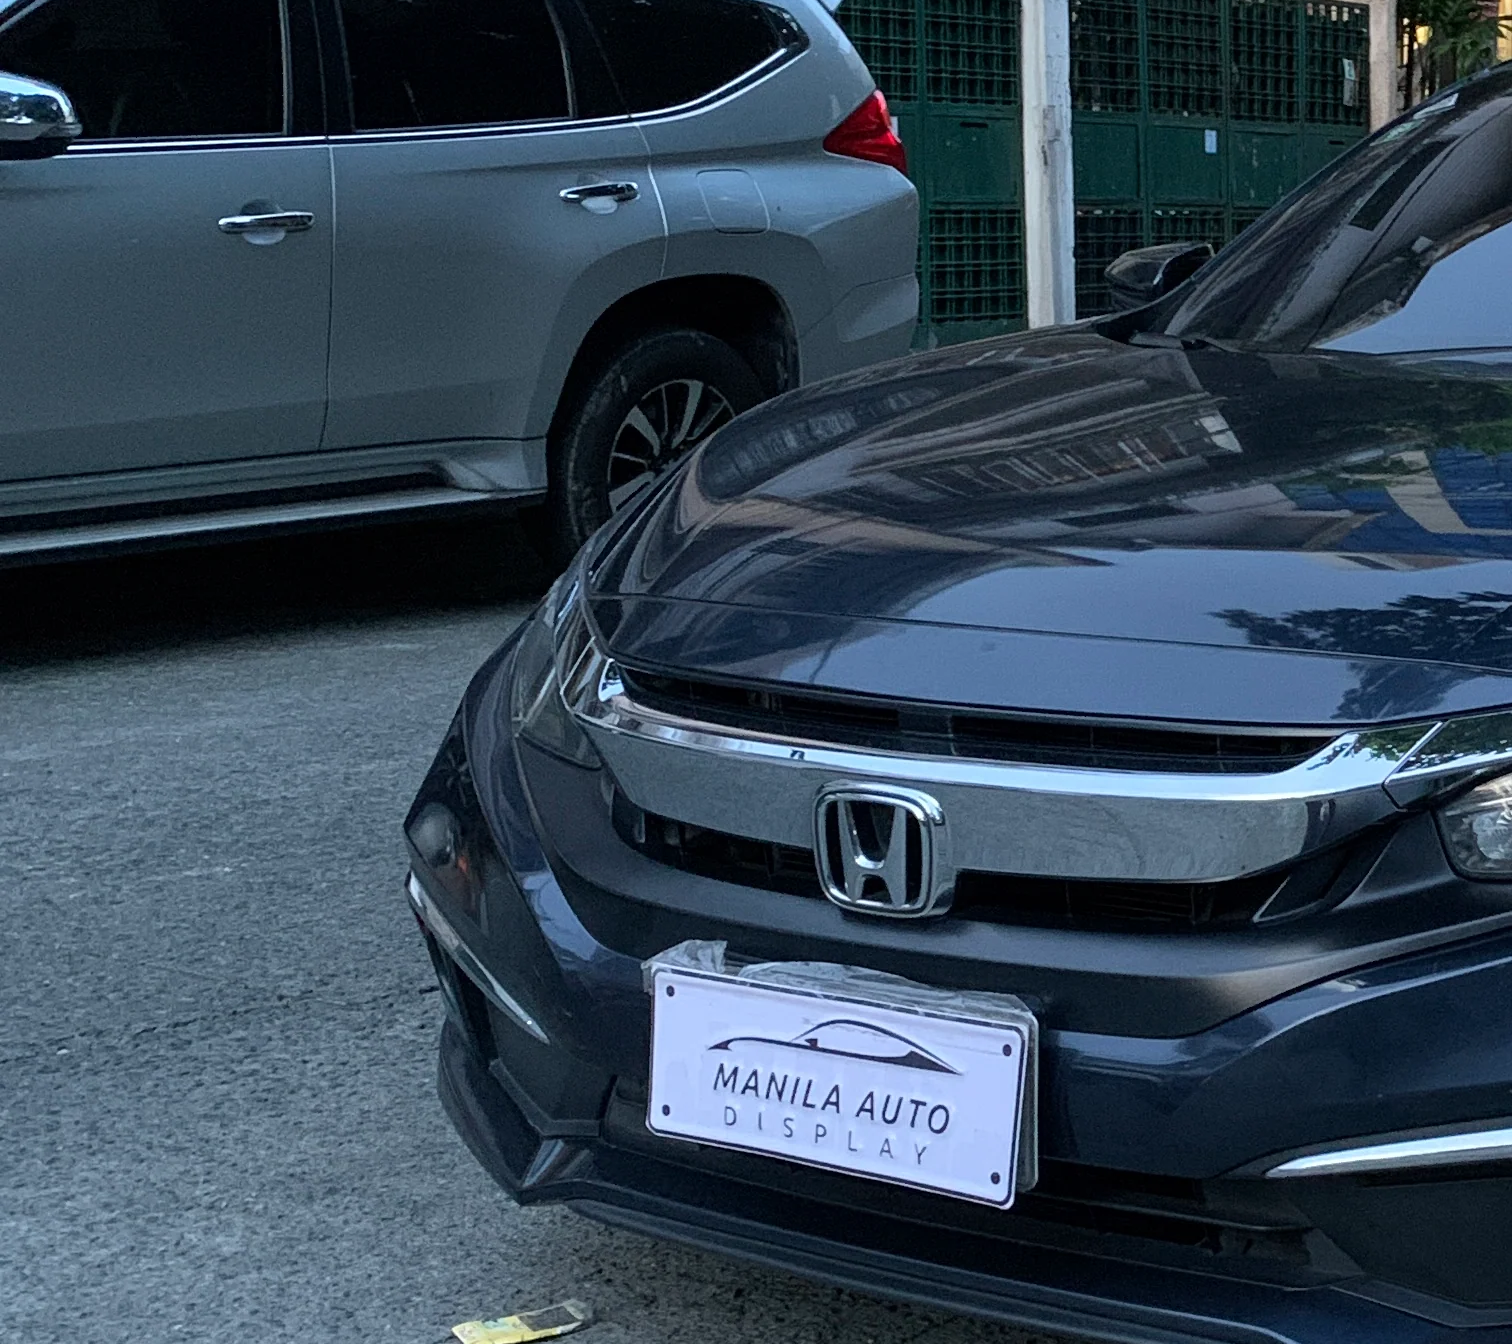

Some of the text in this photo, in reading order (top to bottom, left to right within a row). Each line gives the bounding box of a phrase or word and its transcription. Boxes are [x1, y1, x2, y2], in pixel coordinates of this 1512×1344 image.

[713, 1063, 950, 1134] MANILA AUTO
[725, 1106, 928, 1165] DISPLAY
